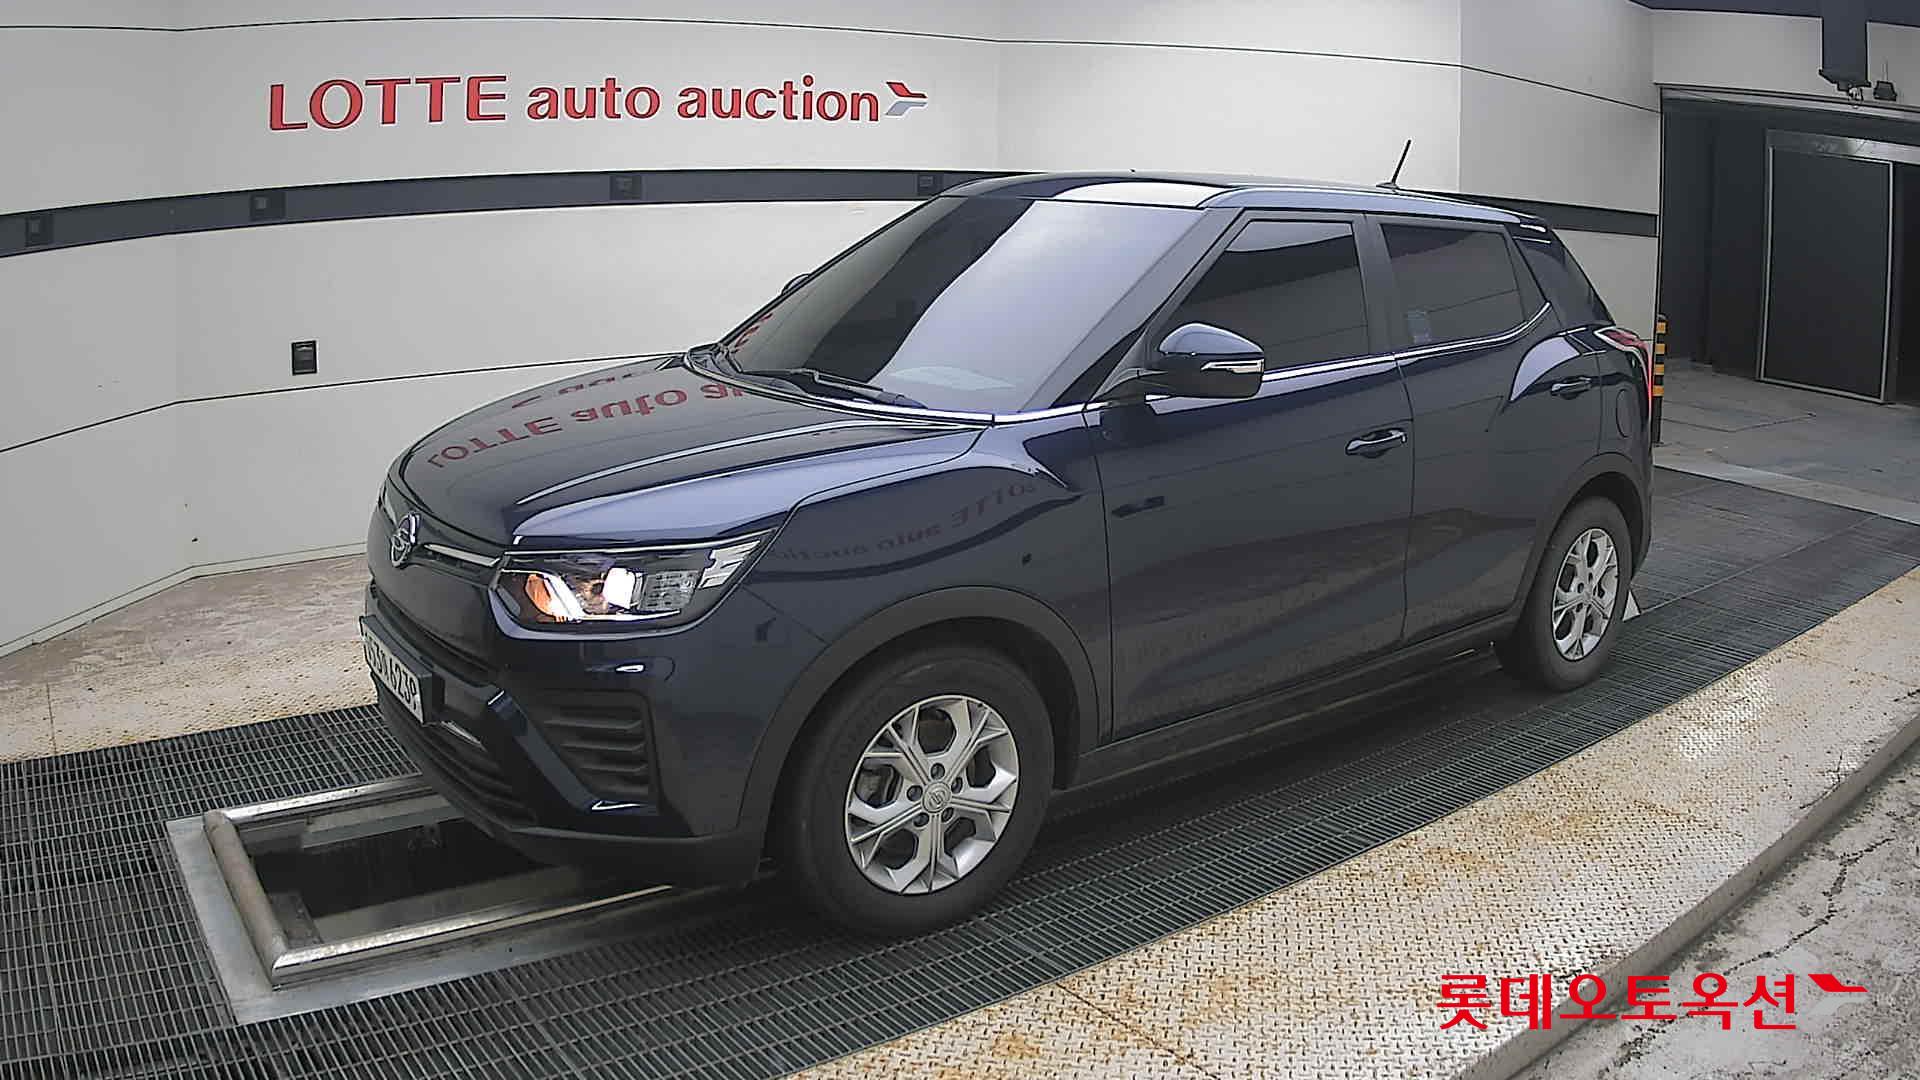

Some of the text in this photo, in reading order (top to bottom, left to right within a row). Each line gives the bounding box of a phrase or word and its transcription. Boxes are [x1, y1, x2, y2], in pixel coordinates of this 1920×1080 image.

[268, 75, 881, 131] LOTTE auto auction
